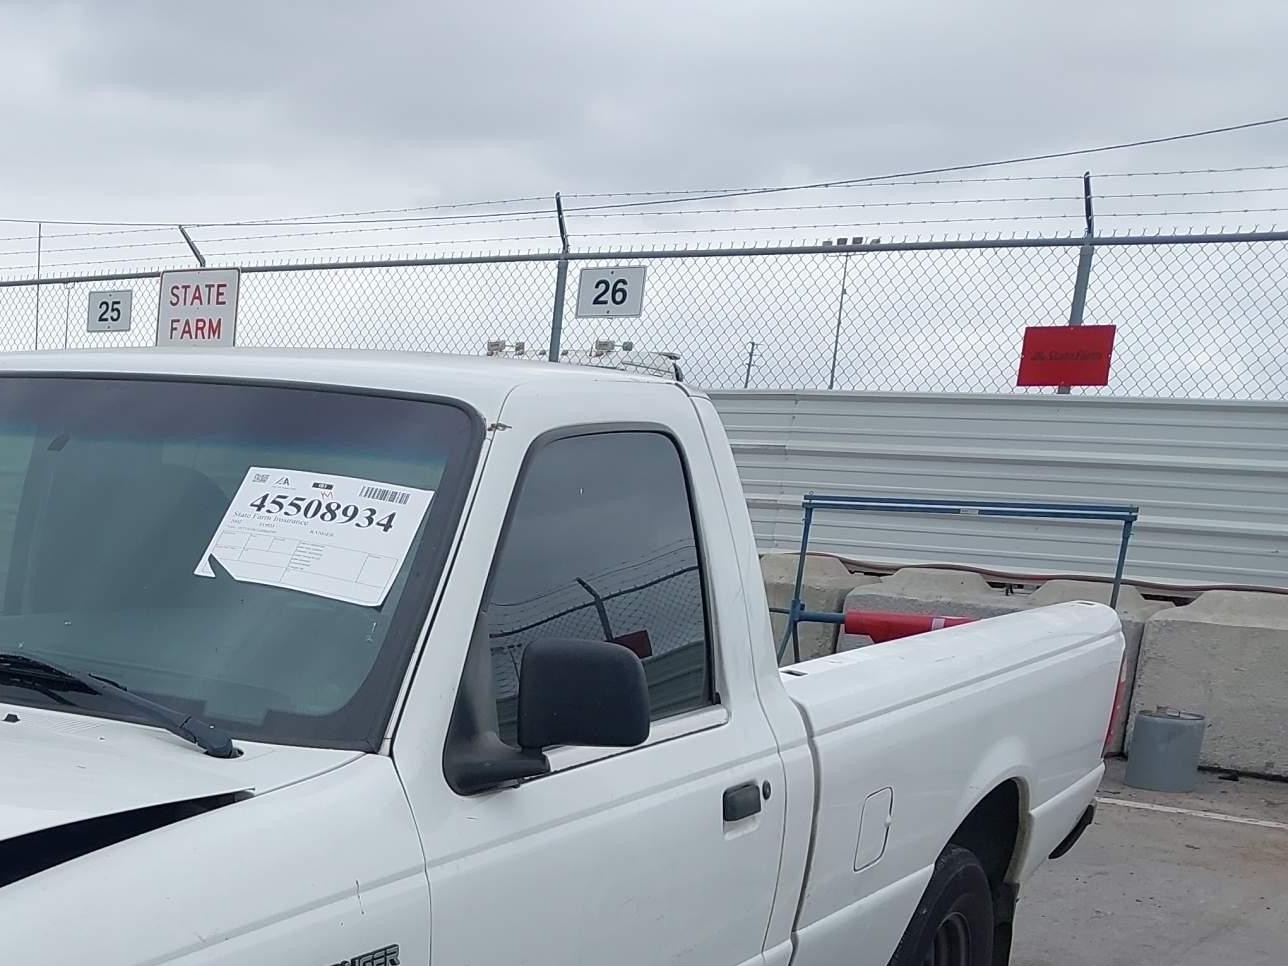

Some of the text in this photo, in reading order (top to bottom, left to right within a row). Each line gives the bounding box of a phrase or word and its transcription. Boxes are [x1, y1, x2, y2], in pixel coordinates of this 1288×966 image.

[169, 283, 227, 307] STATE
[592, 278, 629, 306] 26
[98, 300, 121, 322] 25
[169, 318, 222, 340] FARM
[233, 511, 310, 526] State Farm Insurance
[250, 492, 397, 533] 45508934
